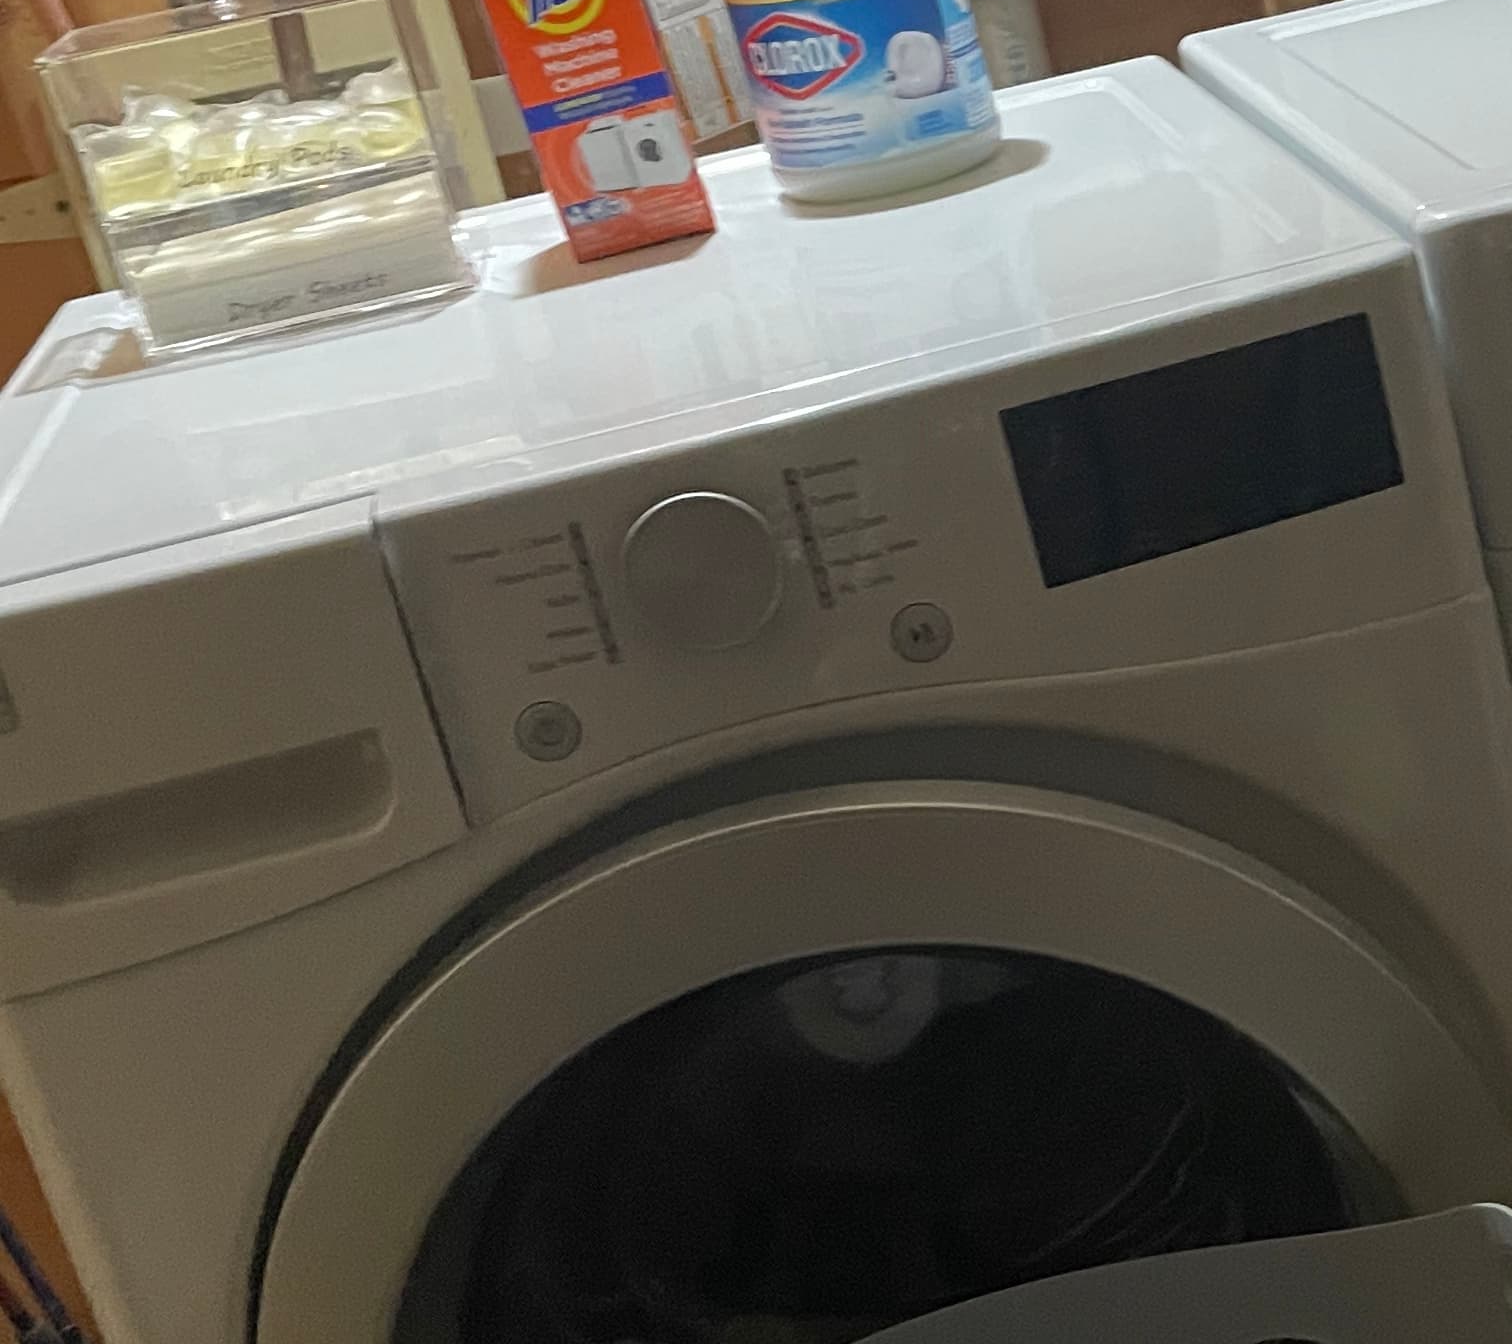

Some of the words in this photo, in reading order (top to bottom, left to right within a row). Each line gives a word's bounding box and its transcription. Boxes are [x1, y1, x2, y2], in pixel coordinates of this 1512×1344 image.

[530, 28, 617, 59] Washing
[747, 33, 848, 77] CLOROX
[542, 47, 620, 77] Machine
[551, 65, 622, 94] Cleaner
